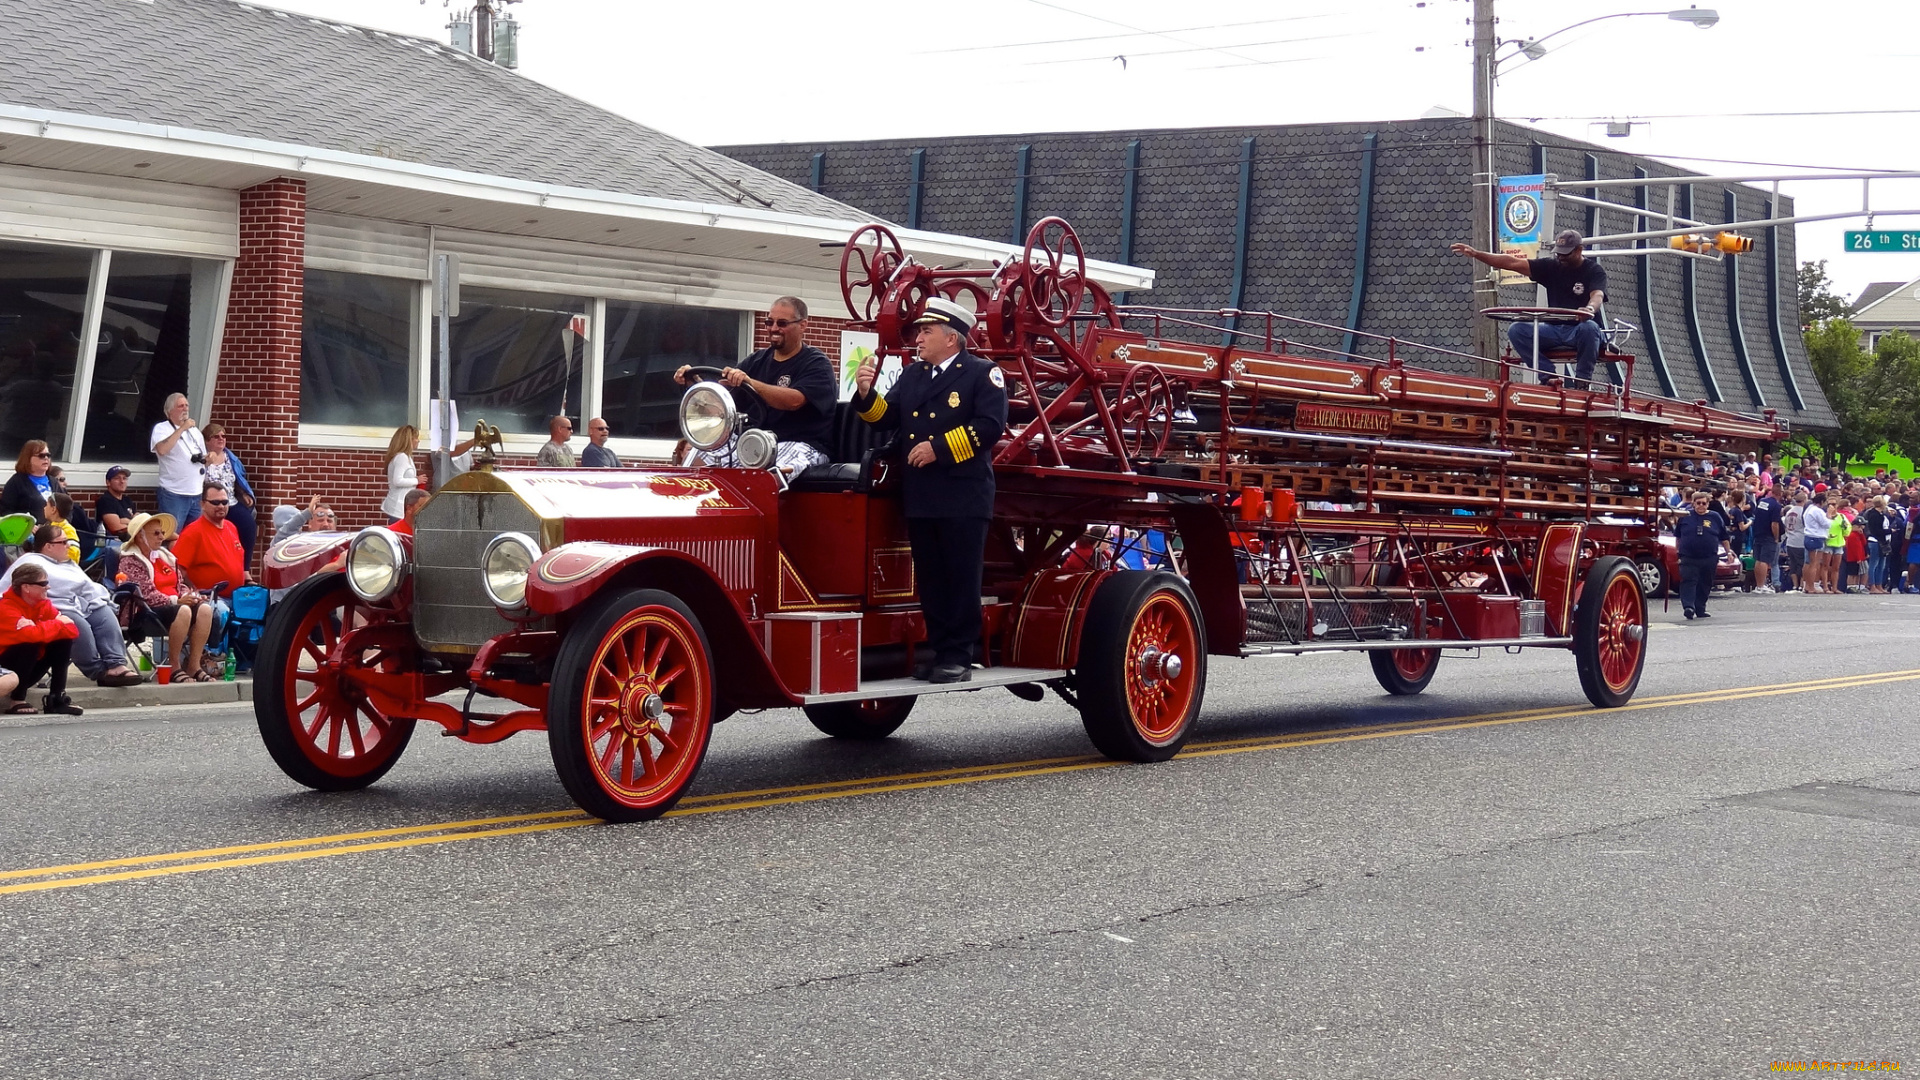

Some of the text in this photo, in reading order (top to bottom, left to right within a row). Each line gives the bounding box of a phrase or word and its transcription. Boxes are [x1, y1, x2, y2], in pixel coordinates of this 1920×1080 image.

[1500, 184, 1544, 193] WELCOME
[1854, 234, 1872, 249] 26
[1879, 234, 1890, 244] th
[1313, 409, 1353, 428] AMERICAN
